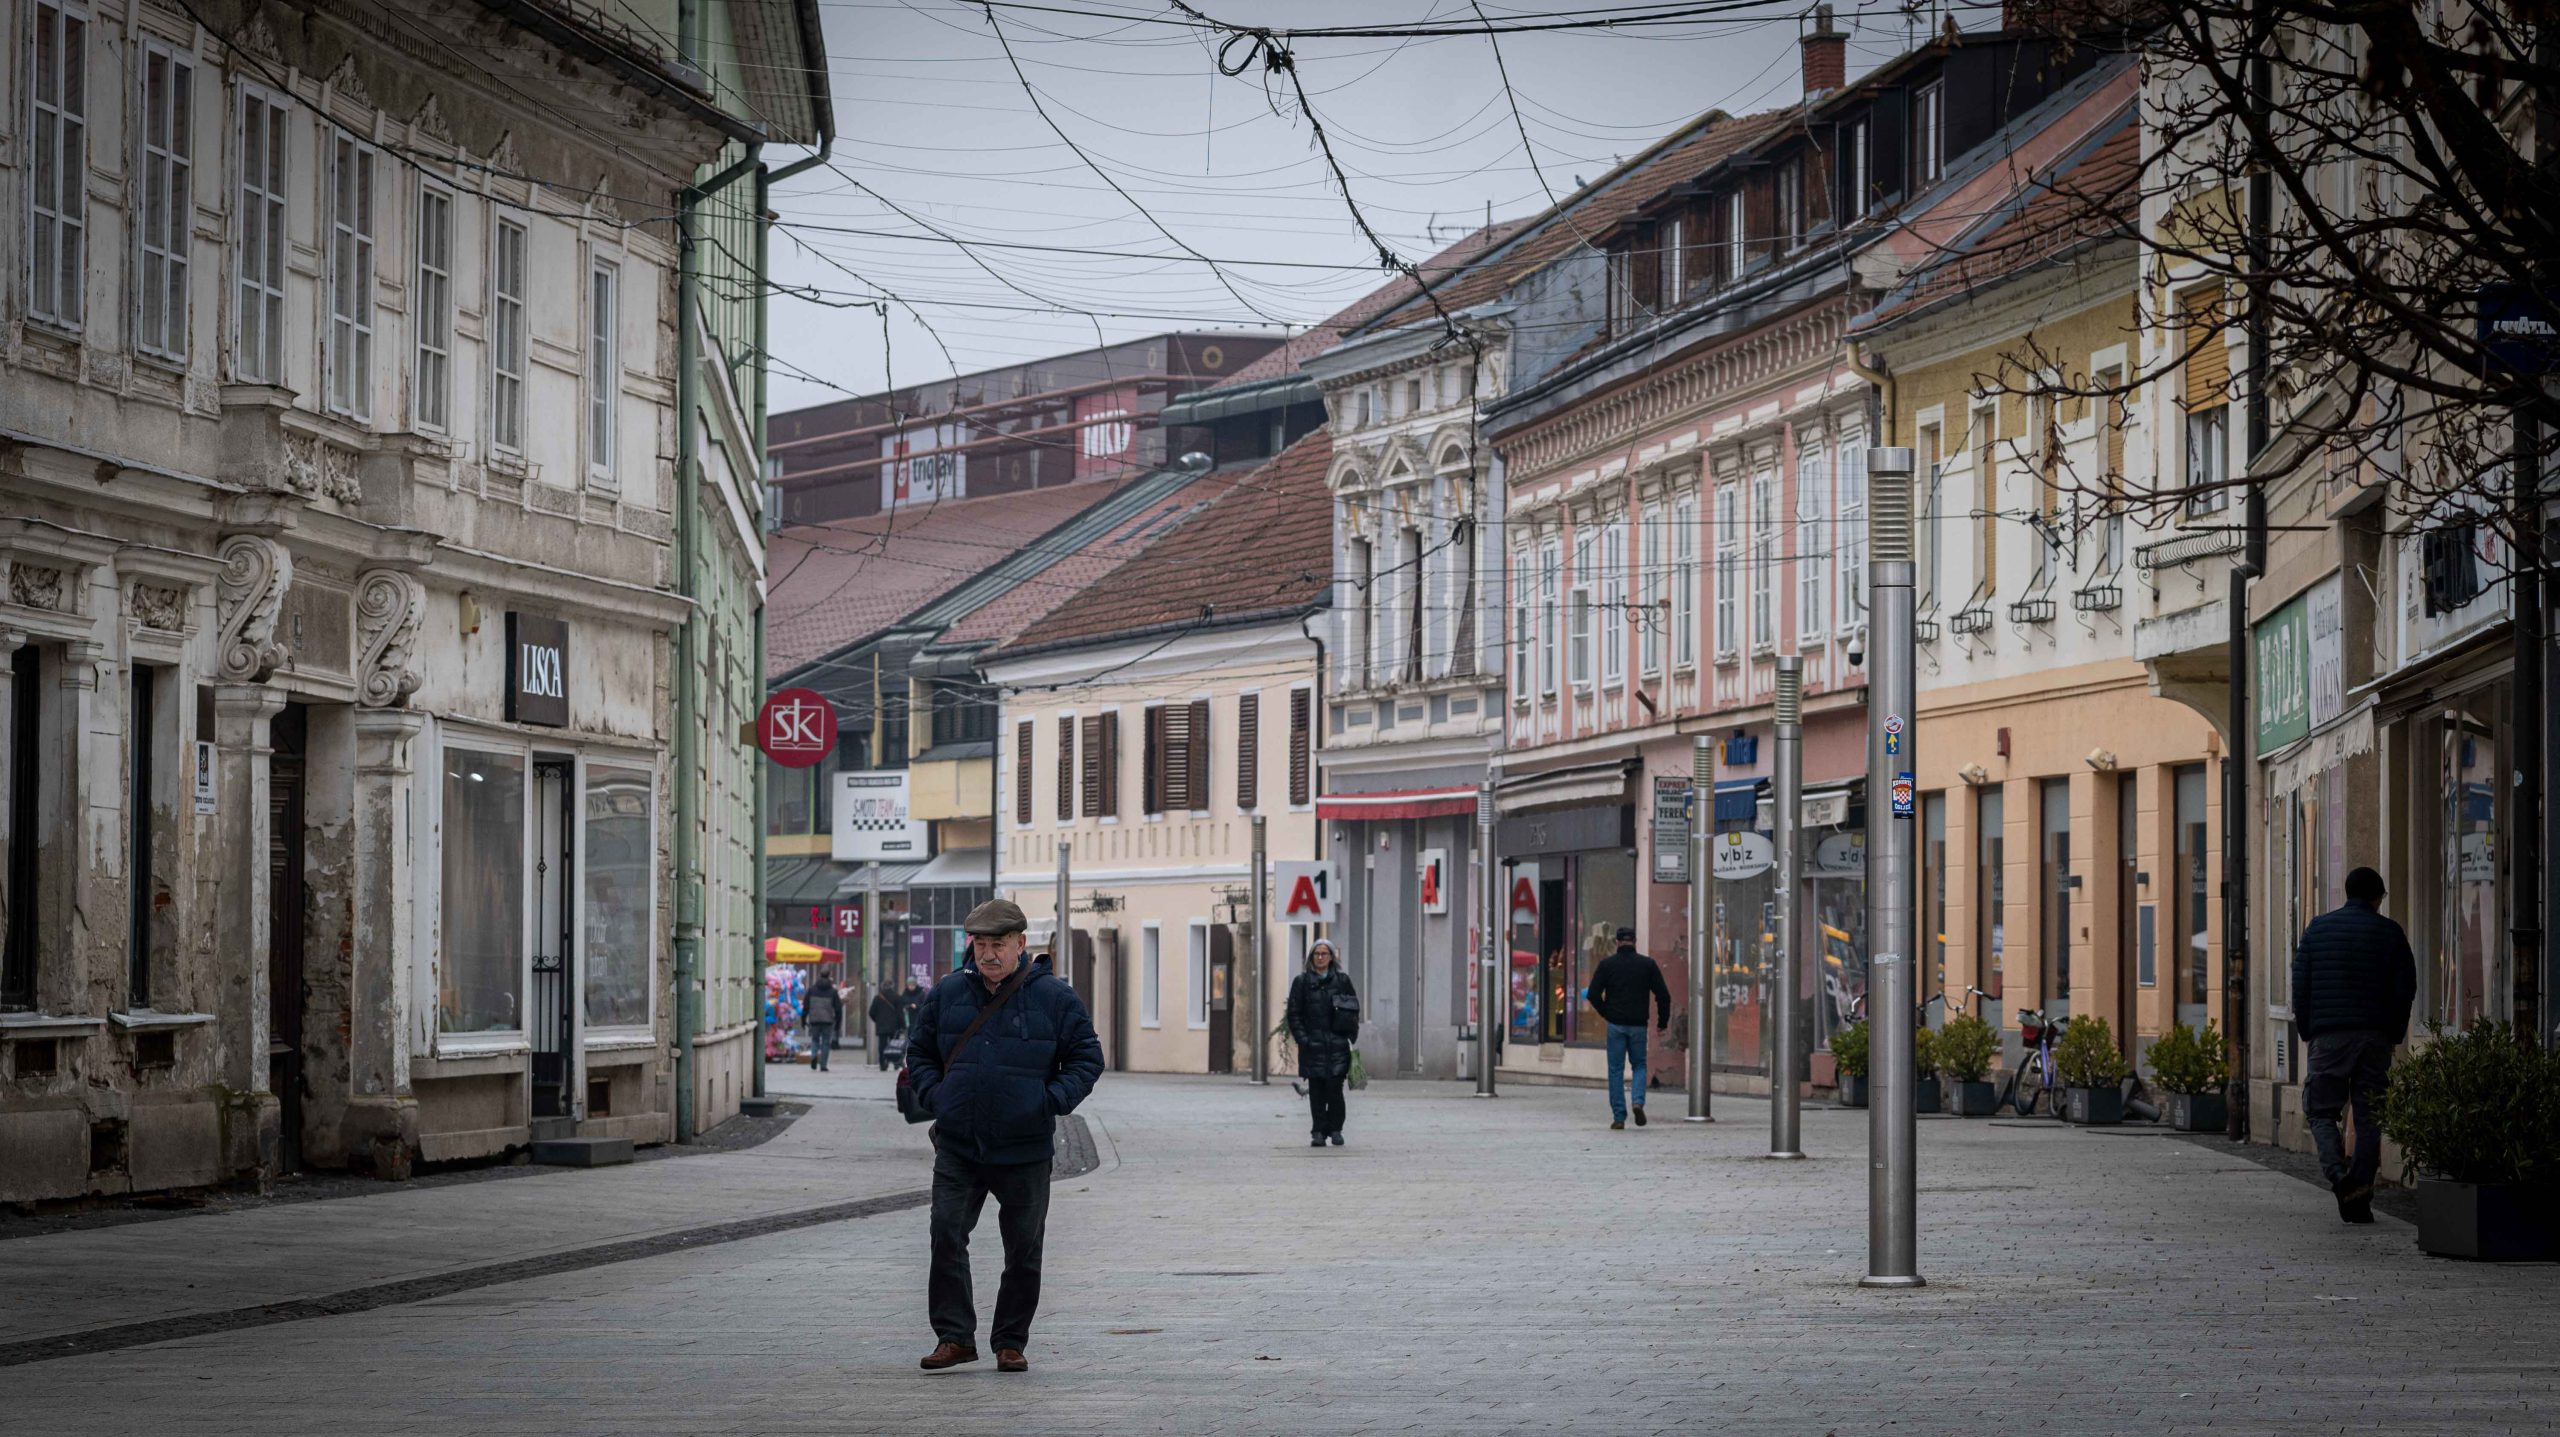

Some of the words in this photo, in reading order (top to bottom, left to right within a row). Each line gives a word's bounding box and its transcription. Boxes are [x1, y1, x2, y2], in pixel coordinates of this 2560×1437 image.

[1083, 408, 1131, 459] NKD
[913, 453, 955, 491] trigav
[522, 643, 563, 698] LISCA
[1286, 869, 1327, 915] A1
